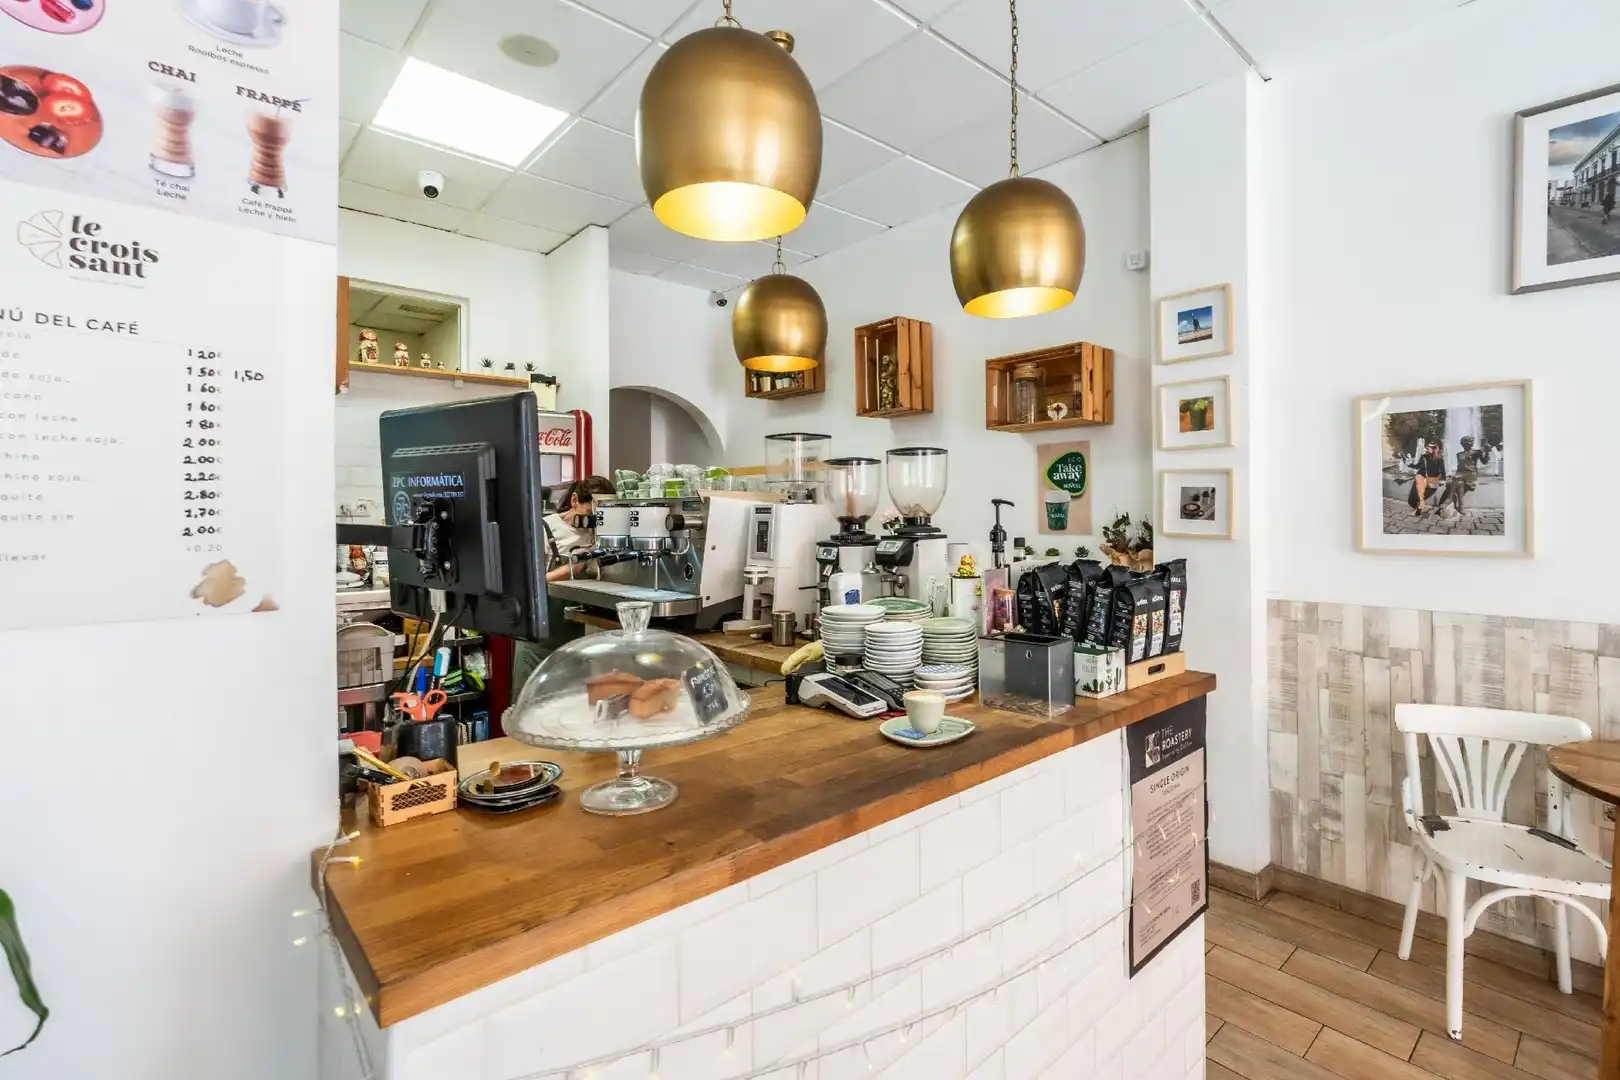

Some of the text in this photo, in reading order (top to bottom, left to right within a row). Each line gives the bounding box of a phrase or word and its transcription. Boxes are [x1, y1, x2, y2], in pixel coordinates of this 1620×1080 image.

[188, 44, 270, 75] Rooibos espresso
[216, 44, 243, 58] Leche
[148, 60, 197, 83] CHAI
[236, 85, 302, 113] FRAPPÉ
[157, 189, 188, 201] Leche
[170, 181, 191, 193] chai
[239, 206, 267, 218] Leche
[72, 214, 102, 237] le
[69, 237, 159, 263] crois
[69, 254, 146, 279] sant
[35, 312, 77, 328] DEL
[86, 318, 140, 336] CAFÉ
[235, 370, 265, 382] 1,50
[1053, 472, 1083, 482] away
[1056, 463, 1083, 473] Take
[392, 471, 464, 488] ZPC INFORMÁTICA
[1161, 724, 1174, 739] THE
[1161, 728, 1193, 752] ROASTERY
[1150, 775, 1170, 794] SINGLE
[1170, 765, 1190, 782] ORIGIN
